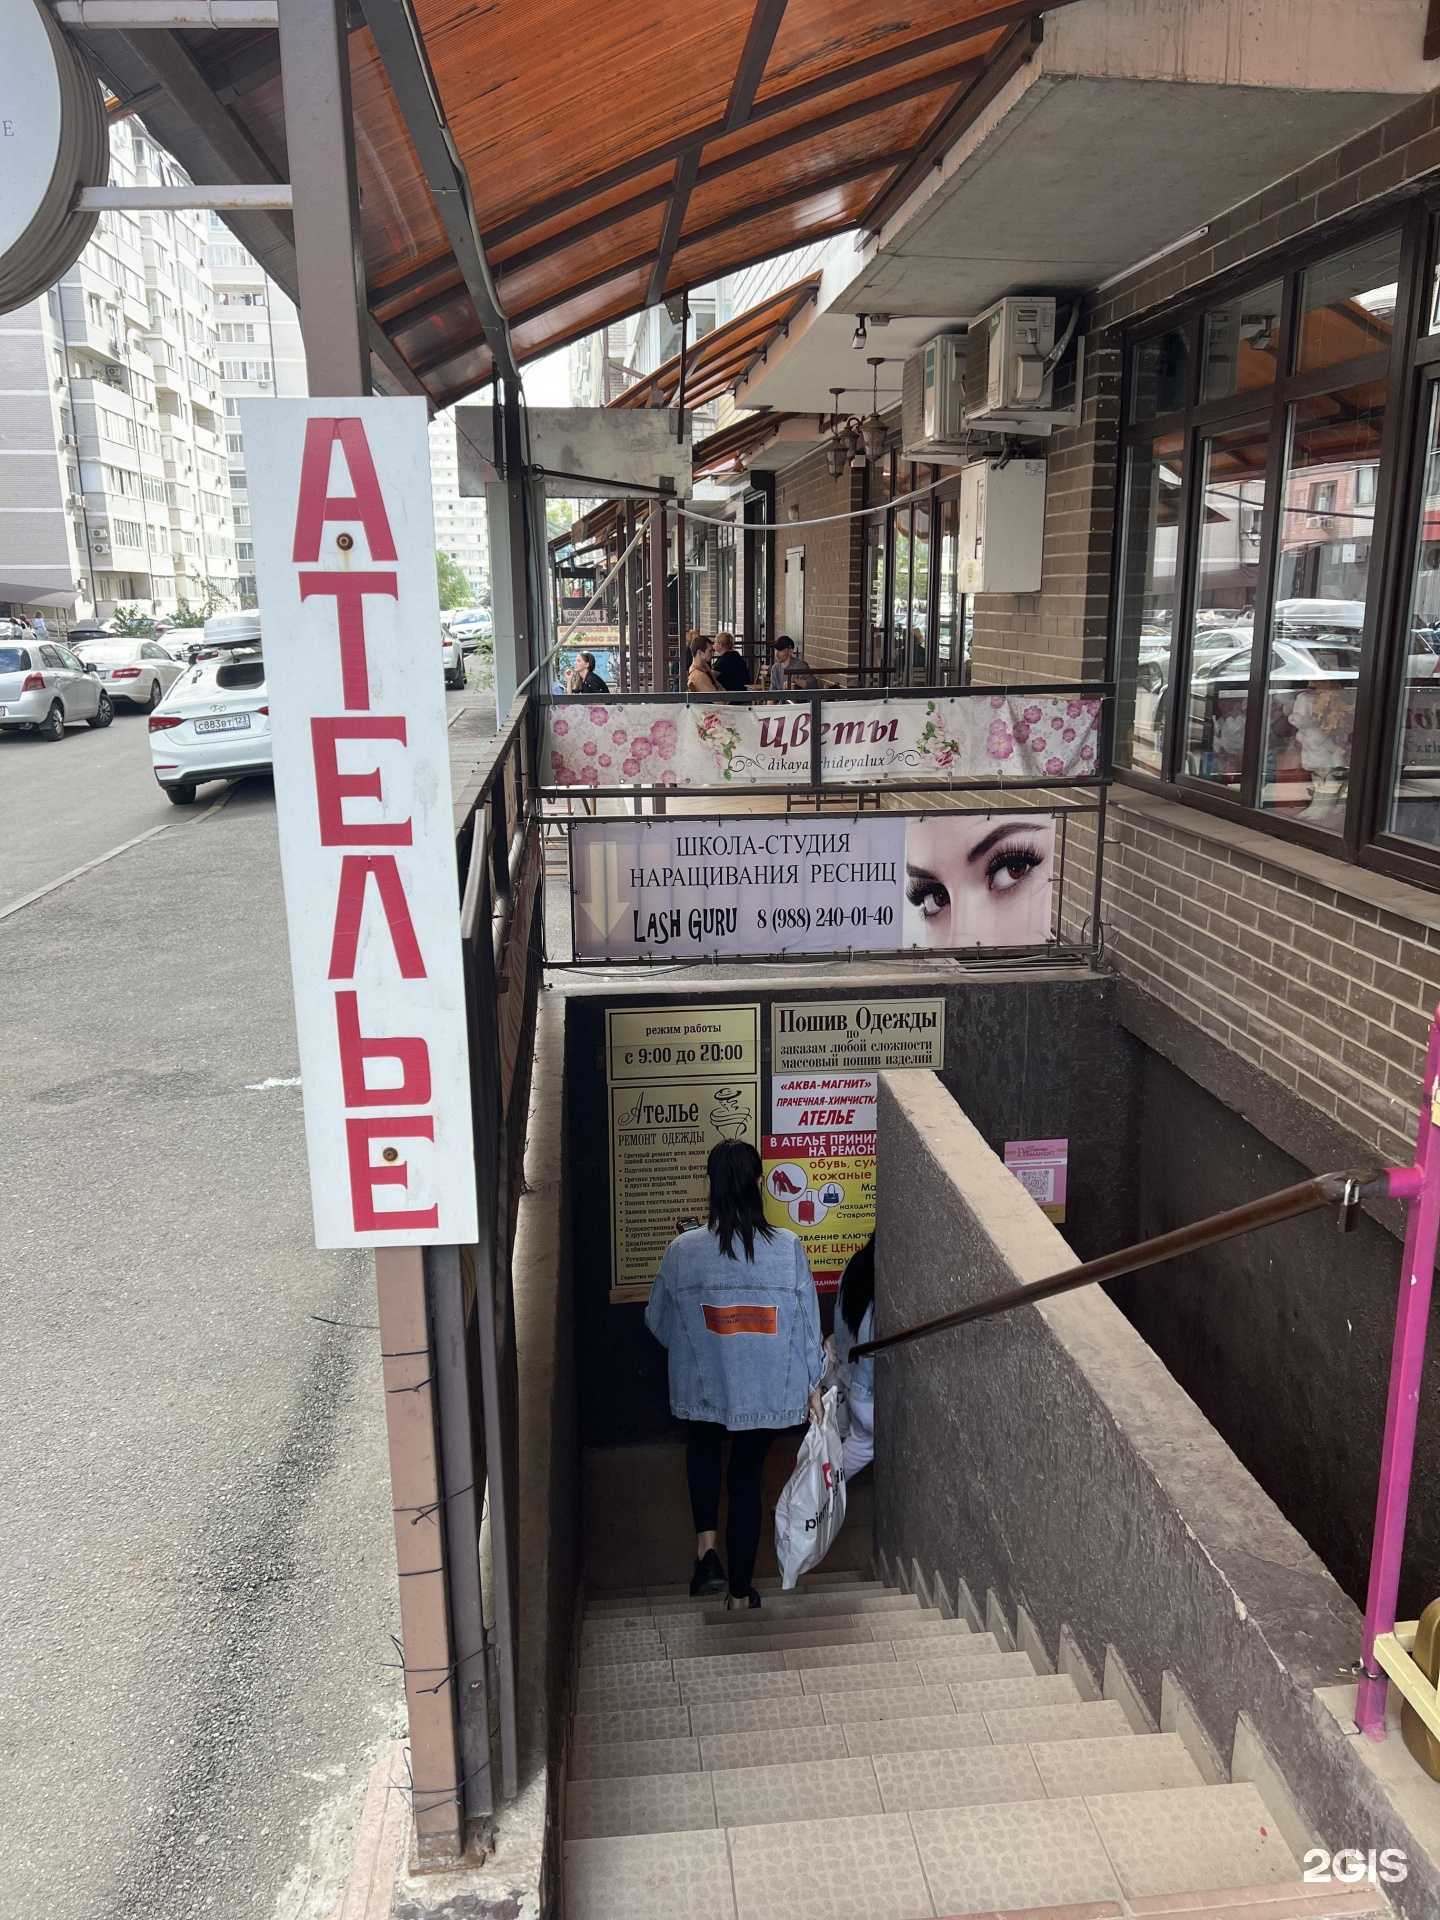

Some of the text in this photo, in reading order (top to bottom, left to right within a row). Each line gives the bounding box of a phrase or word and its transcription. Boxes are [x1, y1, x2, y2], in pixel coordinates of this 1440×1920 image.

[292, 417, 440, 1234] АТЕЛЬЕ
[676, 833, 850, 857] ШКОЛА-СТУДИЯ
[630, 862, 897, 889] НАРАЩИВАНИЯ РЕСНИЦ
[633, 905, 893, 944] LASH GURU 8 (988) 240-01-40
[778, 1006, 937, 1034] Пошив Одежды
[646, 1023, 722, 1036] режим работы
[846, 1029, 859, 1038] по
[624, 1042, 743, 1065] с 9:00 до 20:00
[780, 1038, 933, 1055] заказам любой сложности
[781, 1051, 933, 1069] массовый пошив изделий
[780, 1079, 872, 1091] «АКВА-МАГНИТ»
[617, 1091, 699, 1127] Ателье
[798, 1109, 856, 1126] АТЕЛЬЕ
[618, 1130, 705, 1146] РЕМОНТ ОДЕЖДЫ
[770, 1137, 778, 1147] В
[781, 1135, 827, 1148] АТЕЛЬЕ
[808, 1145, 876, 1157] НА РЕМОН
[809, 1159, 877, 1170] обувь, сум
[812, 1171, 872, 1181] кожаные
[804, 1244, 827, 1254] КИЕ
